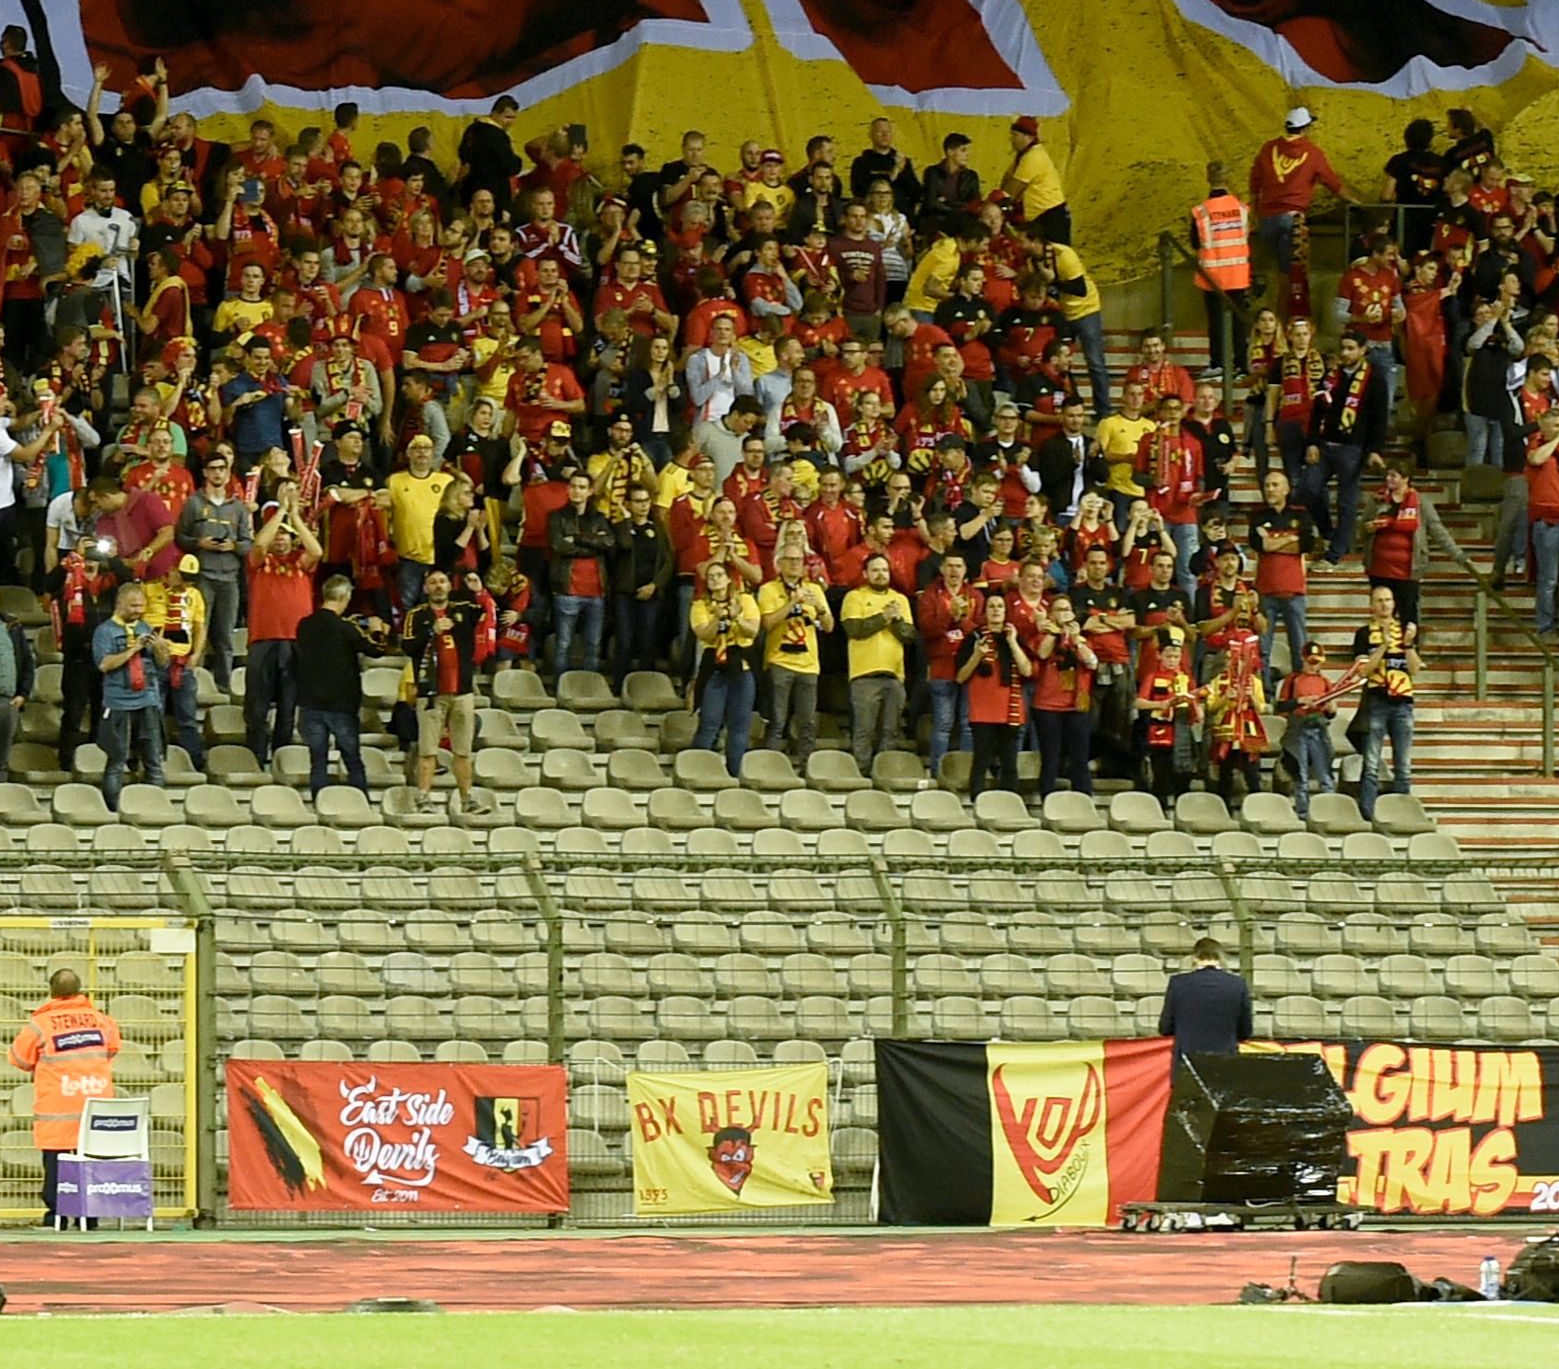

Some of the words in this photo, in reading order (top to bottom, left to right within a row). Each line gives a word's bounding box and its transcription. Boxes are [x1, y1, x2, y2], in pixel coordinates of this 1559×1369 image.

[50, 1013, 98, 1030] STEWARD
[635, 1099, 681, 1142] BX
[700, 1089, 823, 1136] DEVILS
[1336, 1126, 1517, 1216] TRAS
